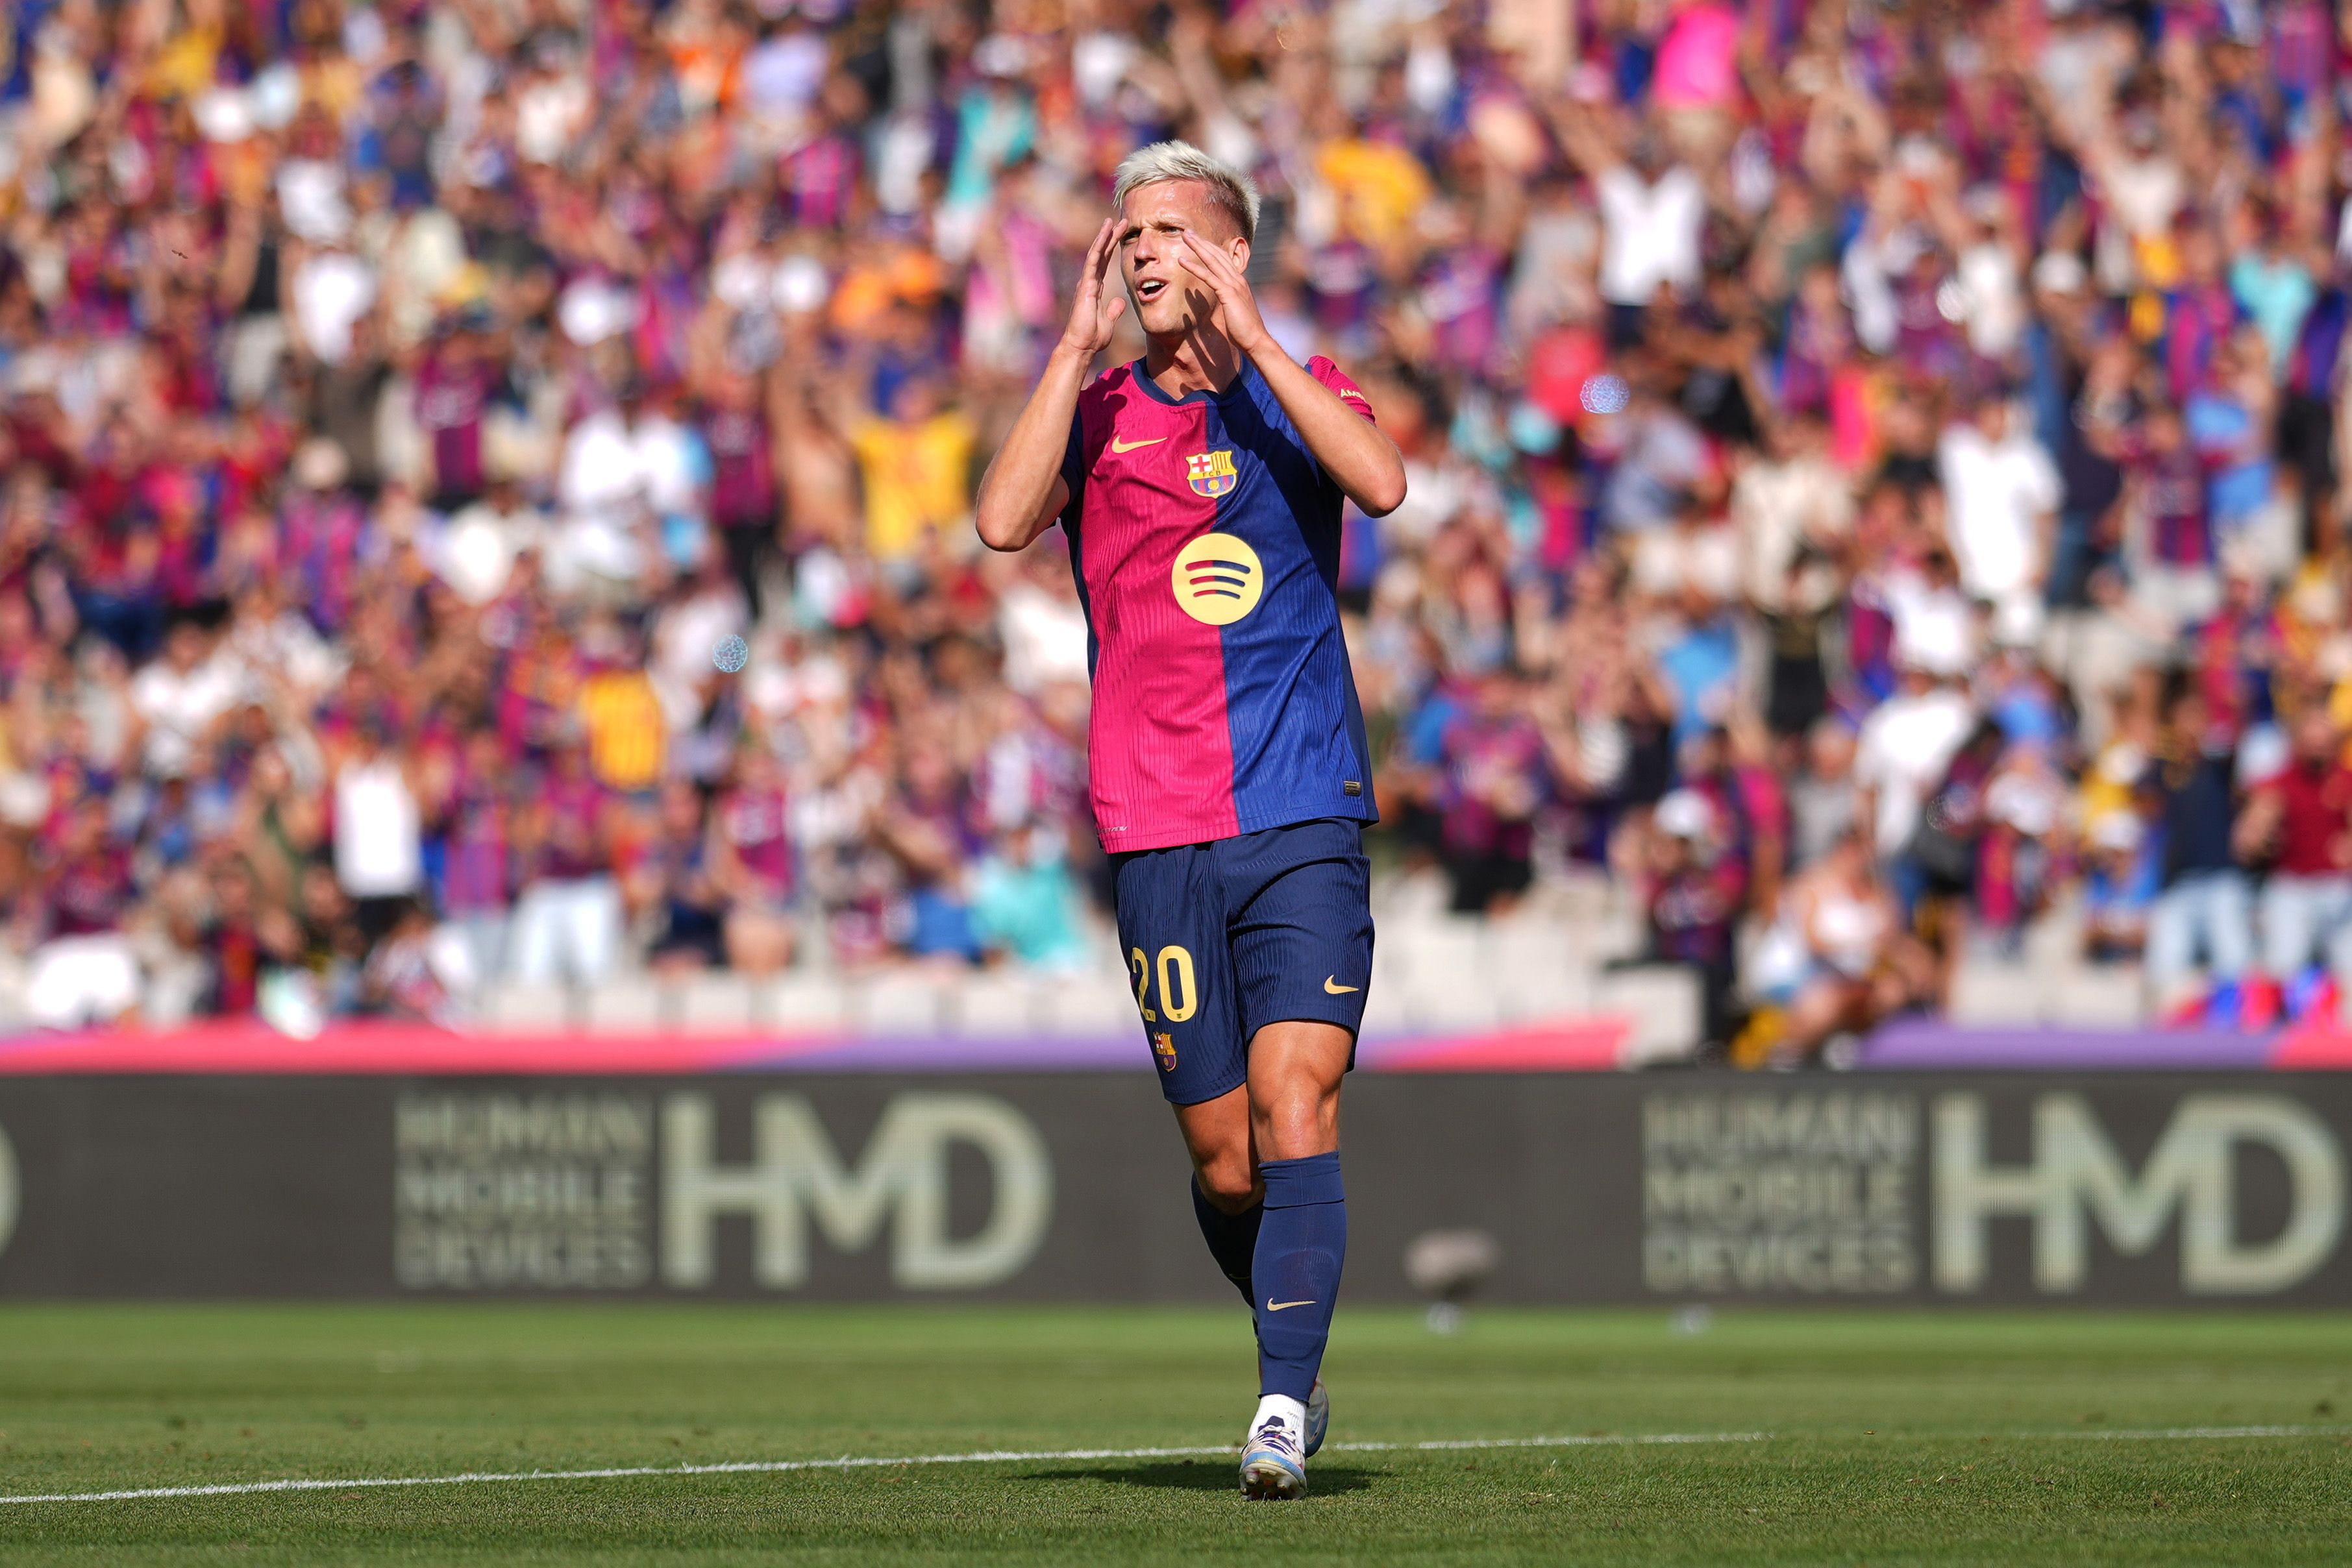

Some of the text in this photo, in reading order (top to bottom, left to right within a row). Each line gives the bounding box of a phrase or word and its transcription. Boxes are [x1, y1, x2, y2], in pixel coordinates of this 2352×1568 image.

[1132, 945, 1197, 1022] 20
[396, 1096, 648, 1158] HUMAN
[1642, 1094, 1919, 1157] HUMAN
[396, 1166, 641, 1221] MOBILE
[660, 1092, 1053, 1290] HMD
[1642, 1166, 1913, 1223] MOBILE
[1931, 1092, 2347, 1293] HMD
[396, 1229, 647, 1289] DEVICES
[1642, 1231, 1918, 1292] DEVICES
